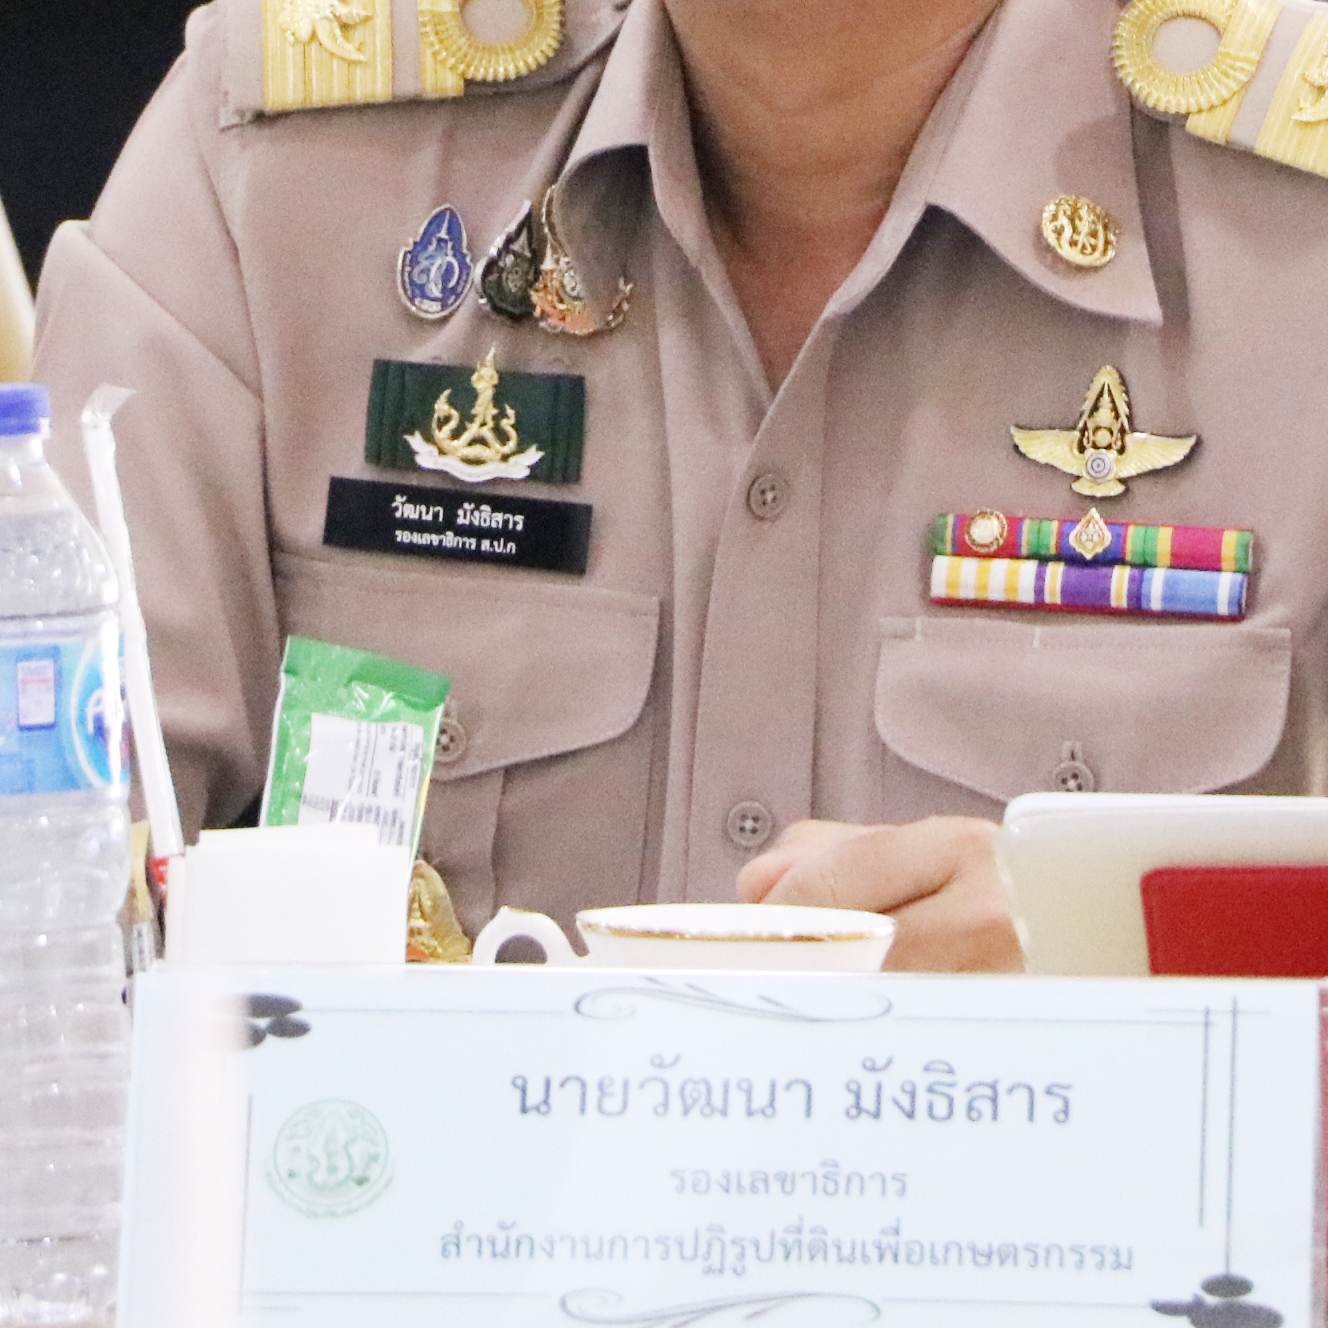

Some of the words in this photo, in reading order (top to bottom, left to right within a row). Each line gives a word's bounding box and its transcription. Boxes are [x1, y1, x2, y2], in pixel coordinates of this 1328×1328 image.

[391, 494, 444, 522] วัฒนา
[456, 502, 525, 531] มังธิสาร
[394, 529, 477, 551] รองเลขาธิการ
[510, 1052, 813, 1118] นายวัฒนา
[844, 1055, 1074, 1123] มังธิสาร
[669, 1158, 909, 1198] รองเลขาธิการ
[438, 1214, 1135, 1277] สำนักงานการปฏิรูปที่ดินเพื่อเกษตรกรรม
